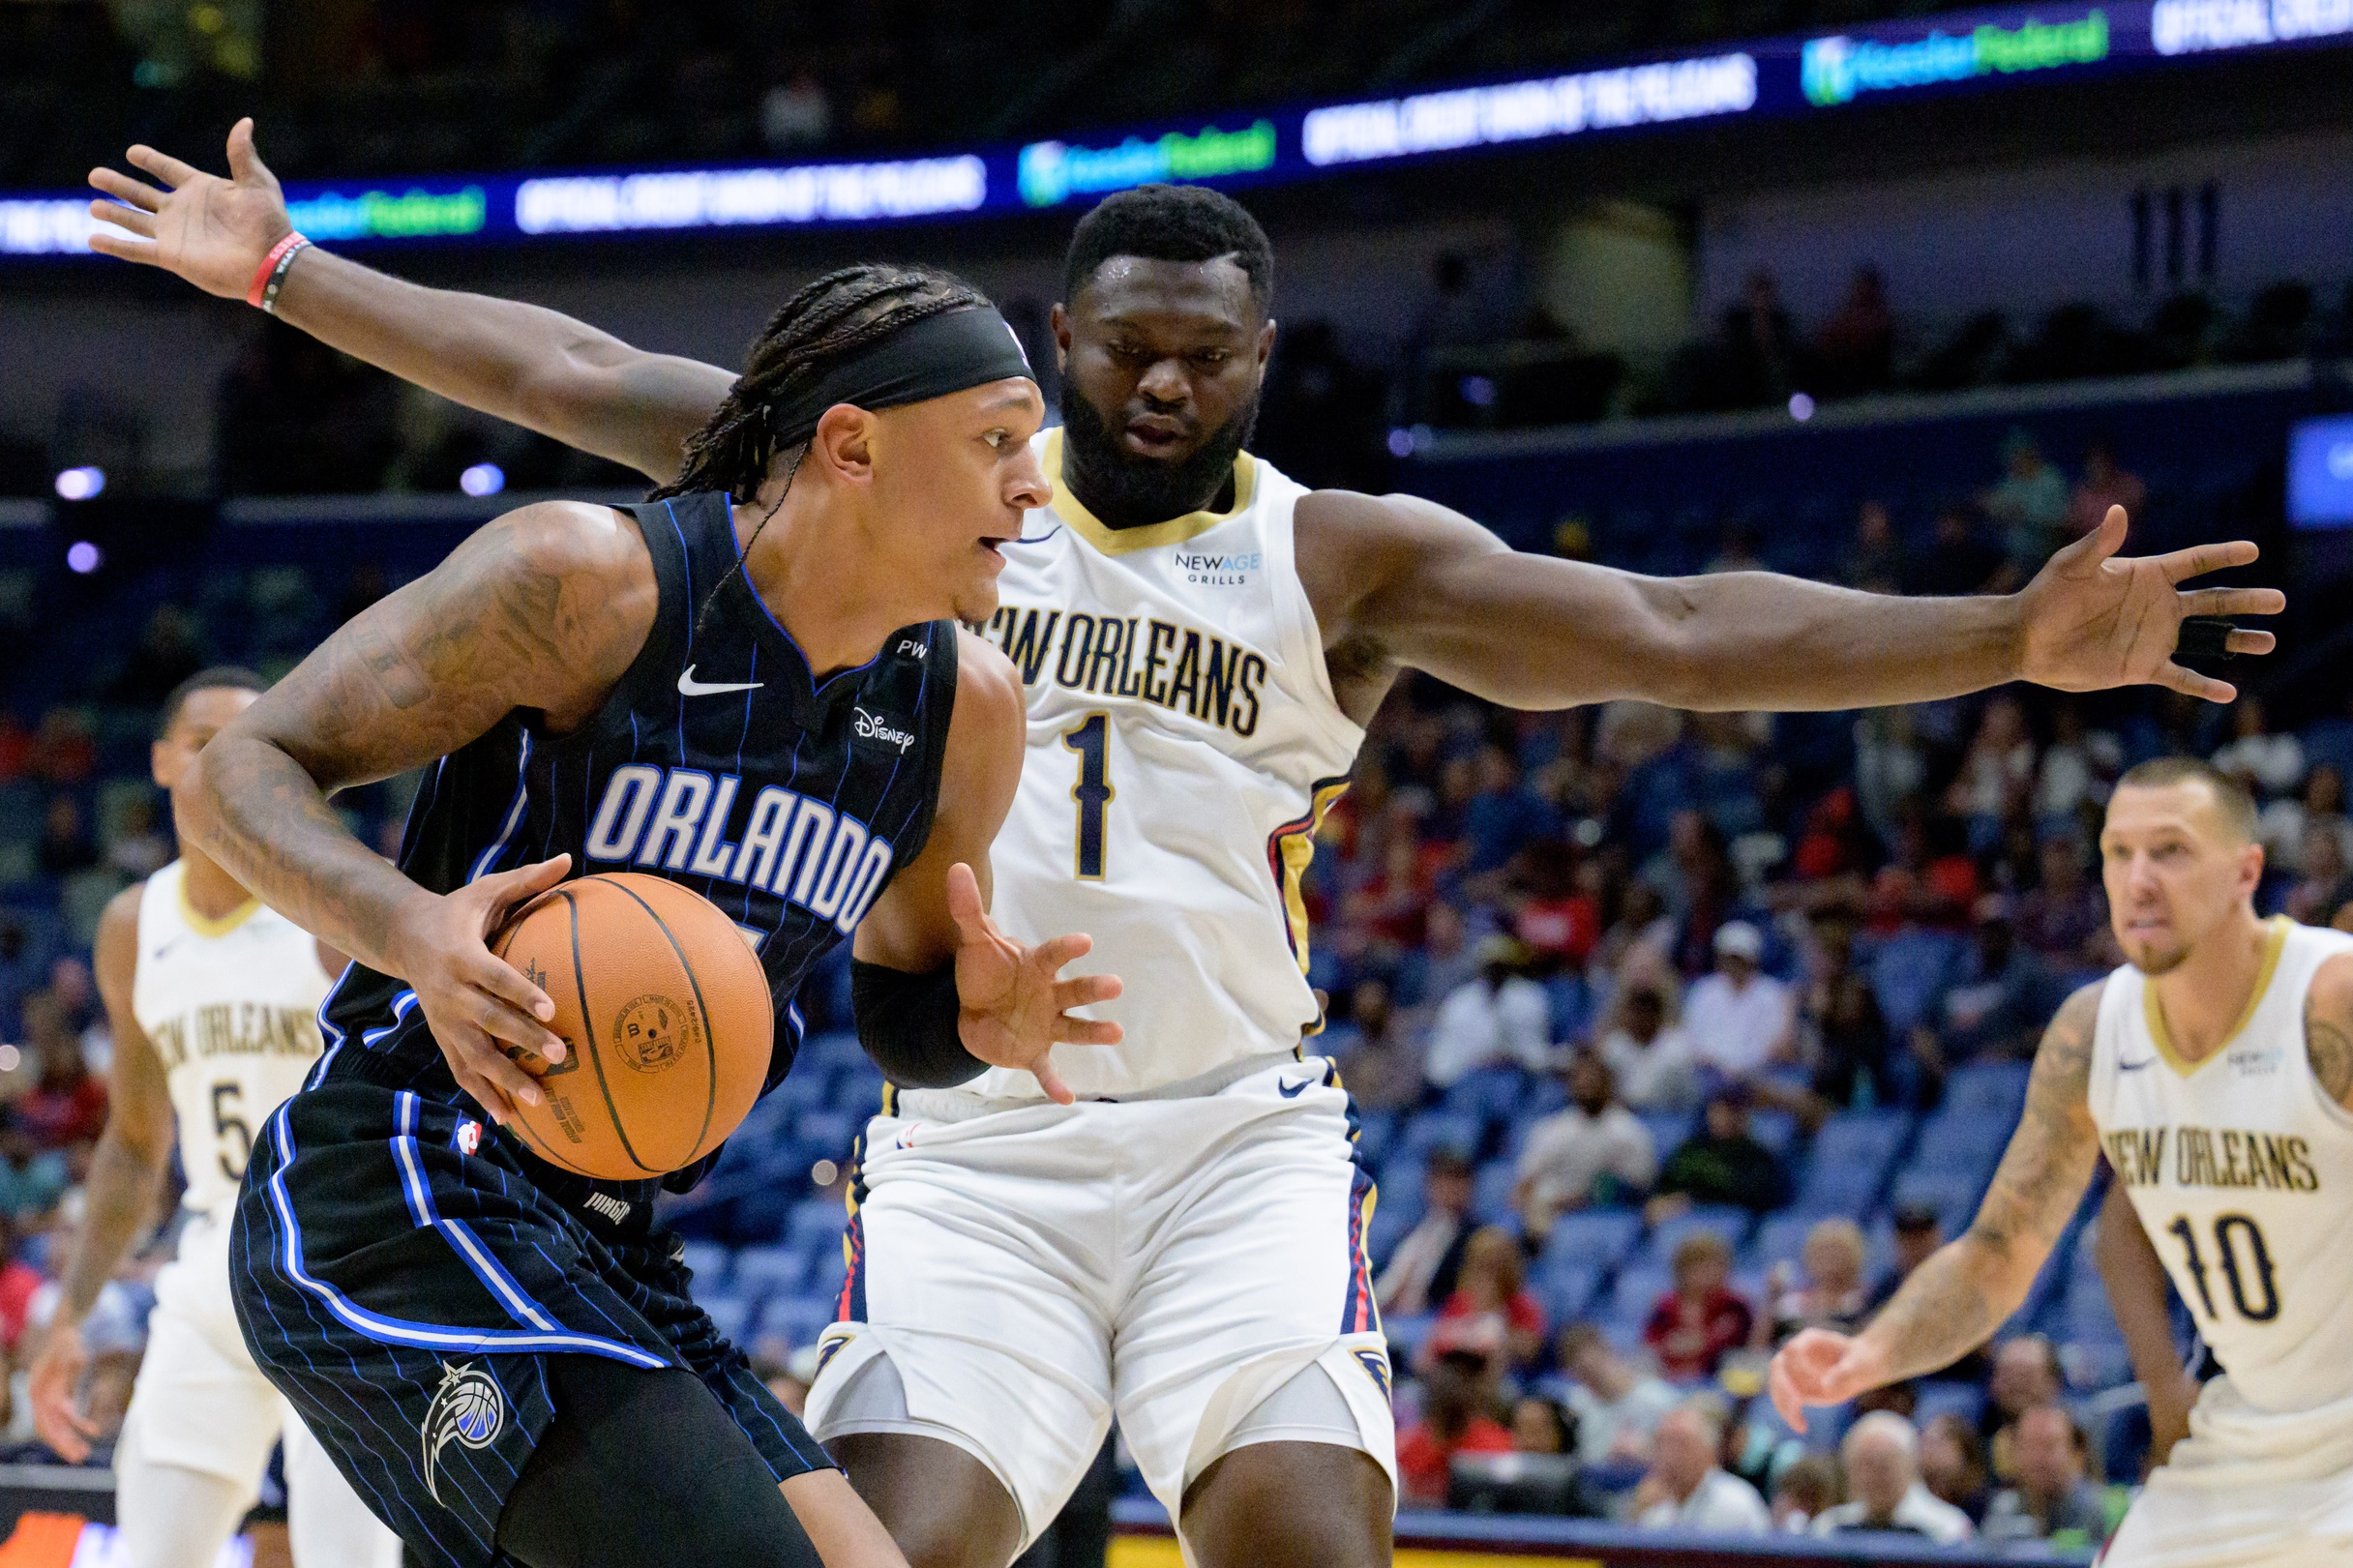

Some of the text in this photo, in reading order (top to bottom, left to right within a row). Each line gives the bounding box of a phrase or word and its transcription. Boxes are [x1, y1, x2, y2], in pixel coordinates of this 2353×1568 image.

[1188, 574, 1245, 584] GRILLS
[896, 639, 927, 659] PW
[1054, 611, 1268, 738] ORLEANS
[583, 762, 894, 935] ORLANDO
[1062, 711, 1116, 881] 1
[210, 1079, 253, 1183] 5
[2177, 1127, 2319, 1194] ORLEANS
[2165, 1212, 2281, 1323] 10
